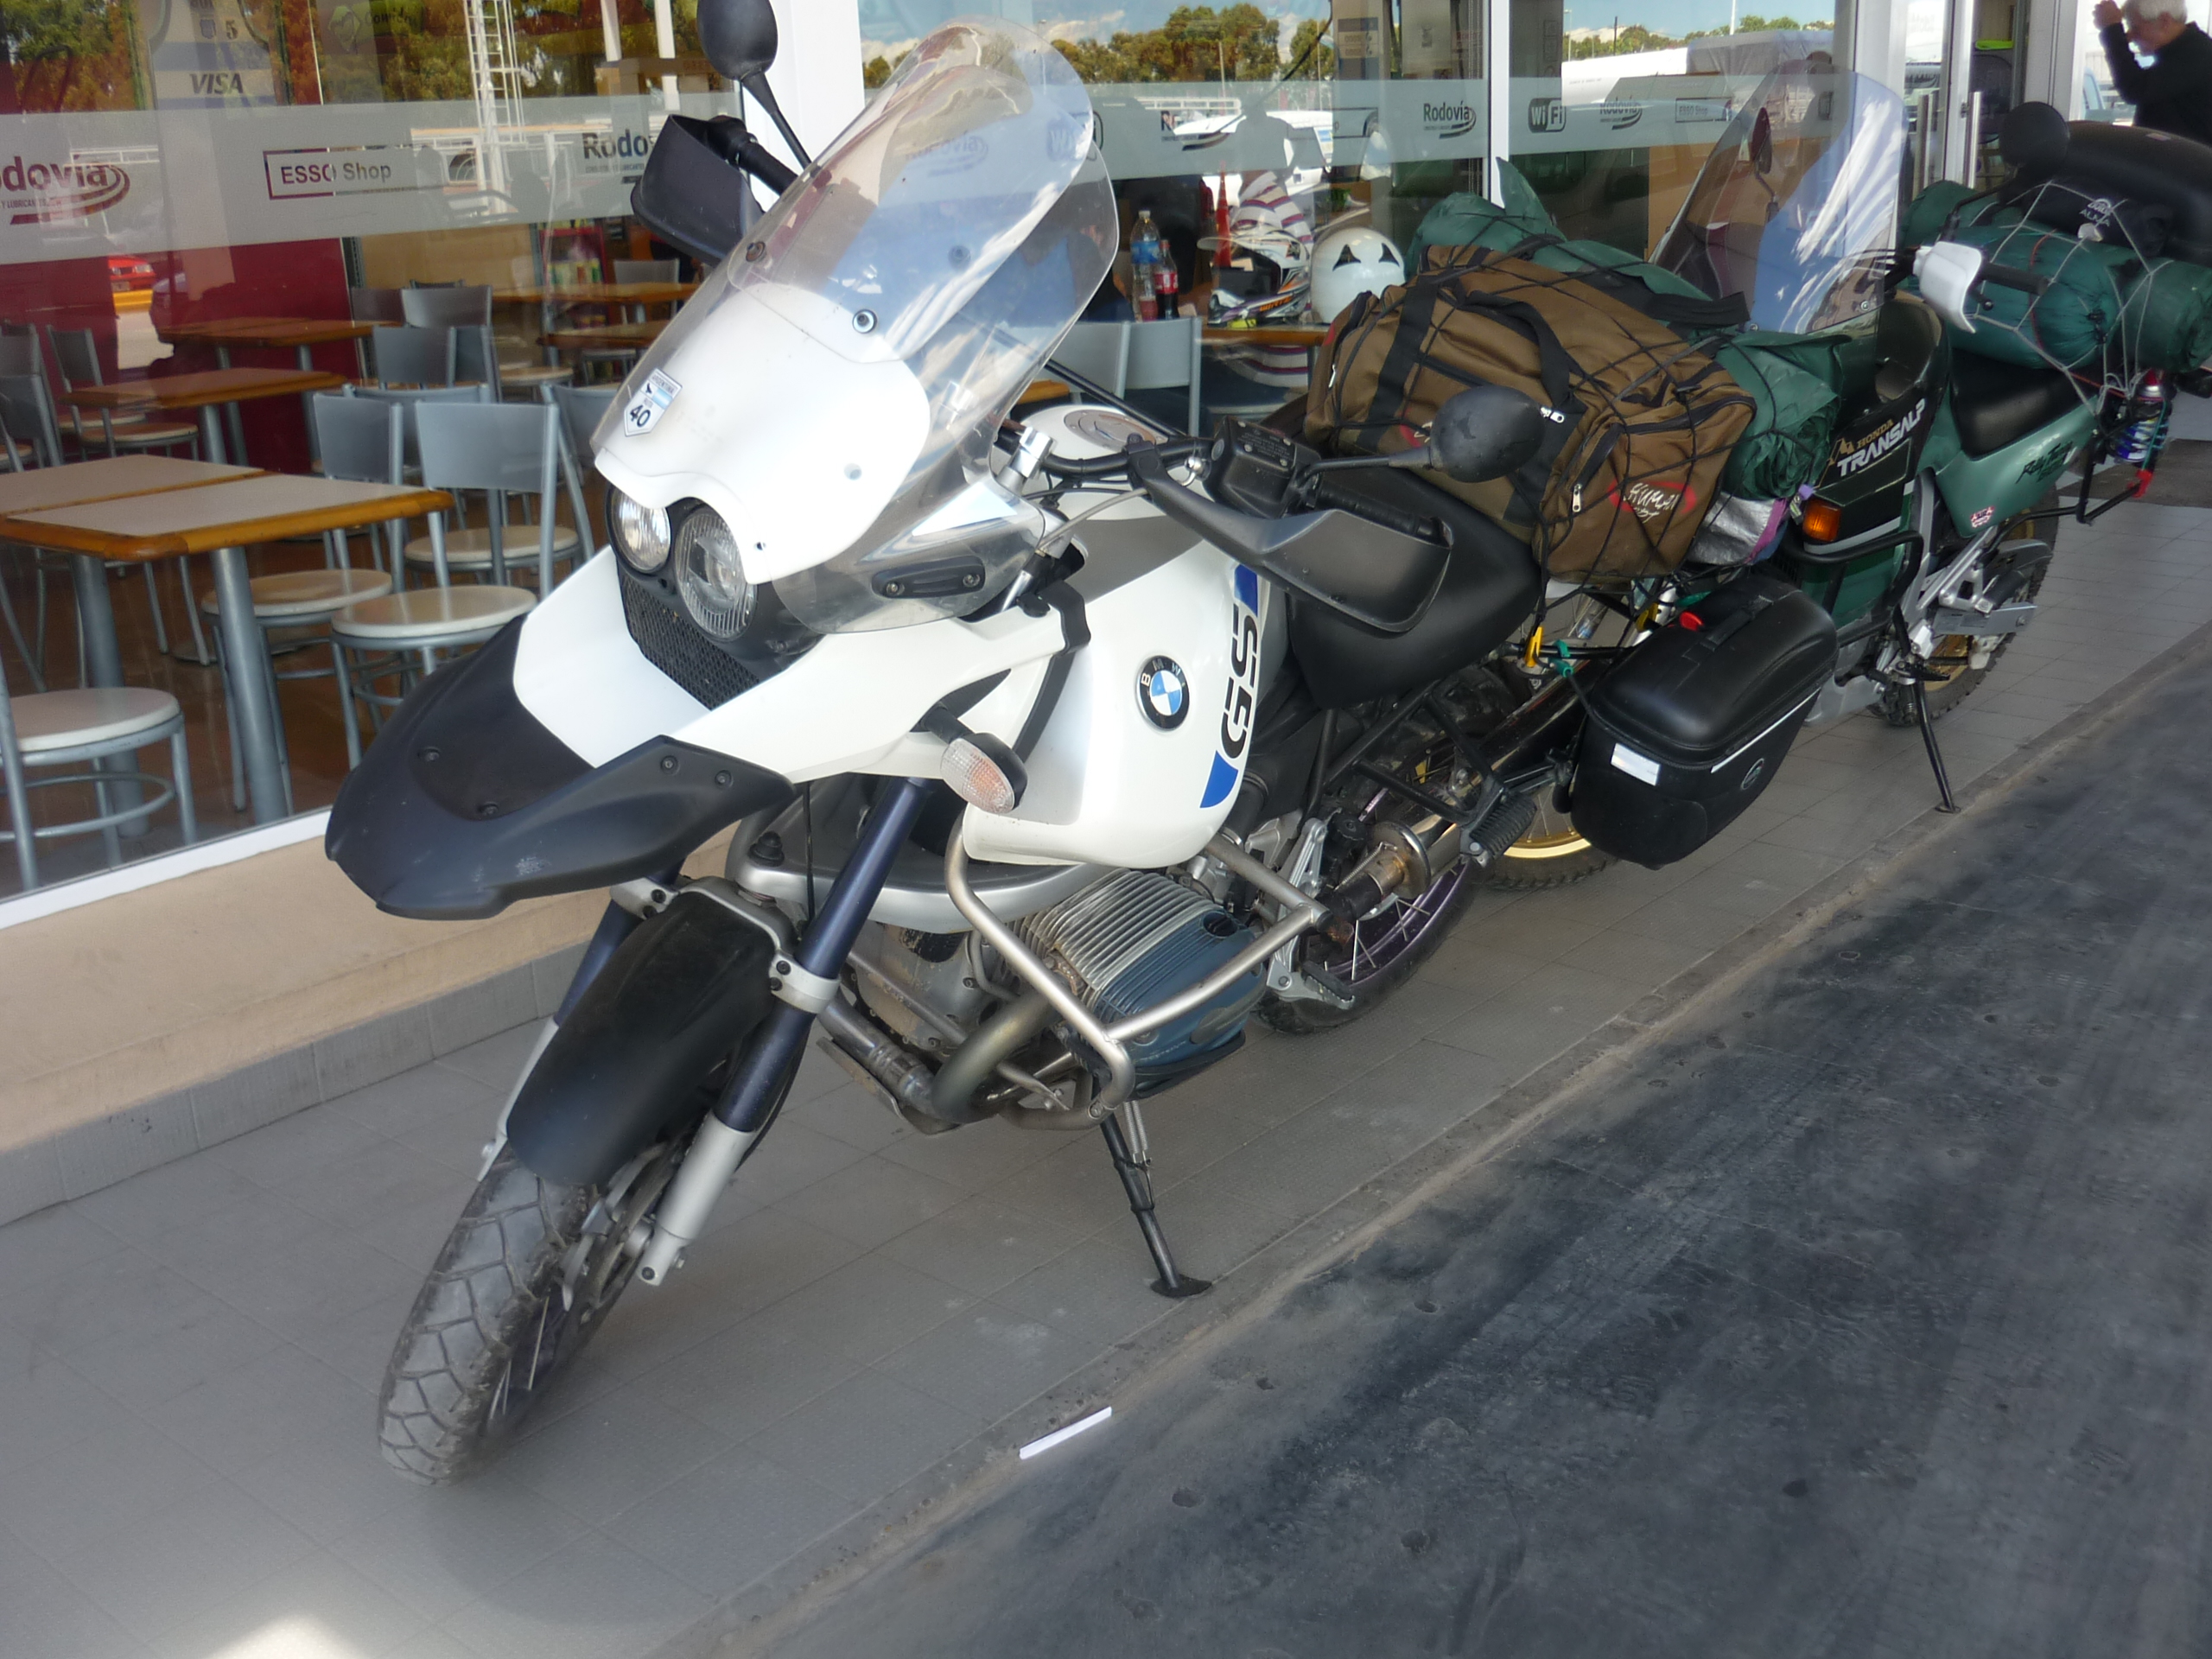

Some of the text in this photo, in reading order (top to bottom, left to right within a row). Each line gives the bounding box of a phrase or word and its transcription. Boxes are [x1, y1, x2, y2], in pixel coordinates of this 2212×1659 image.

[189, 73, 244, 94] VISA
[1423, 99, 1470, 122] Rodovía
[0, 155, 109, 192] dovía
[281, 160, 392, 184] ESSO Shop
[629, 404, 652, 428] 40
[1836, 397, 1926, 477] TRANSALP
[1856, 418, 1895, 449] HONDA
[1140, 657, 1182, 688] BMW
[1220, 602, 1259, 760] GS
